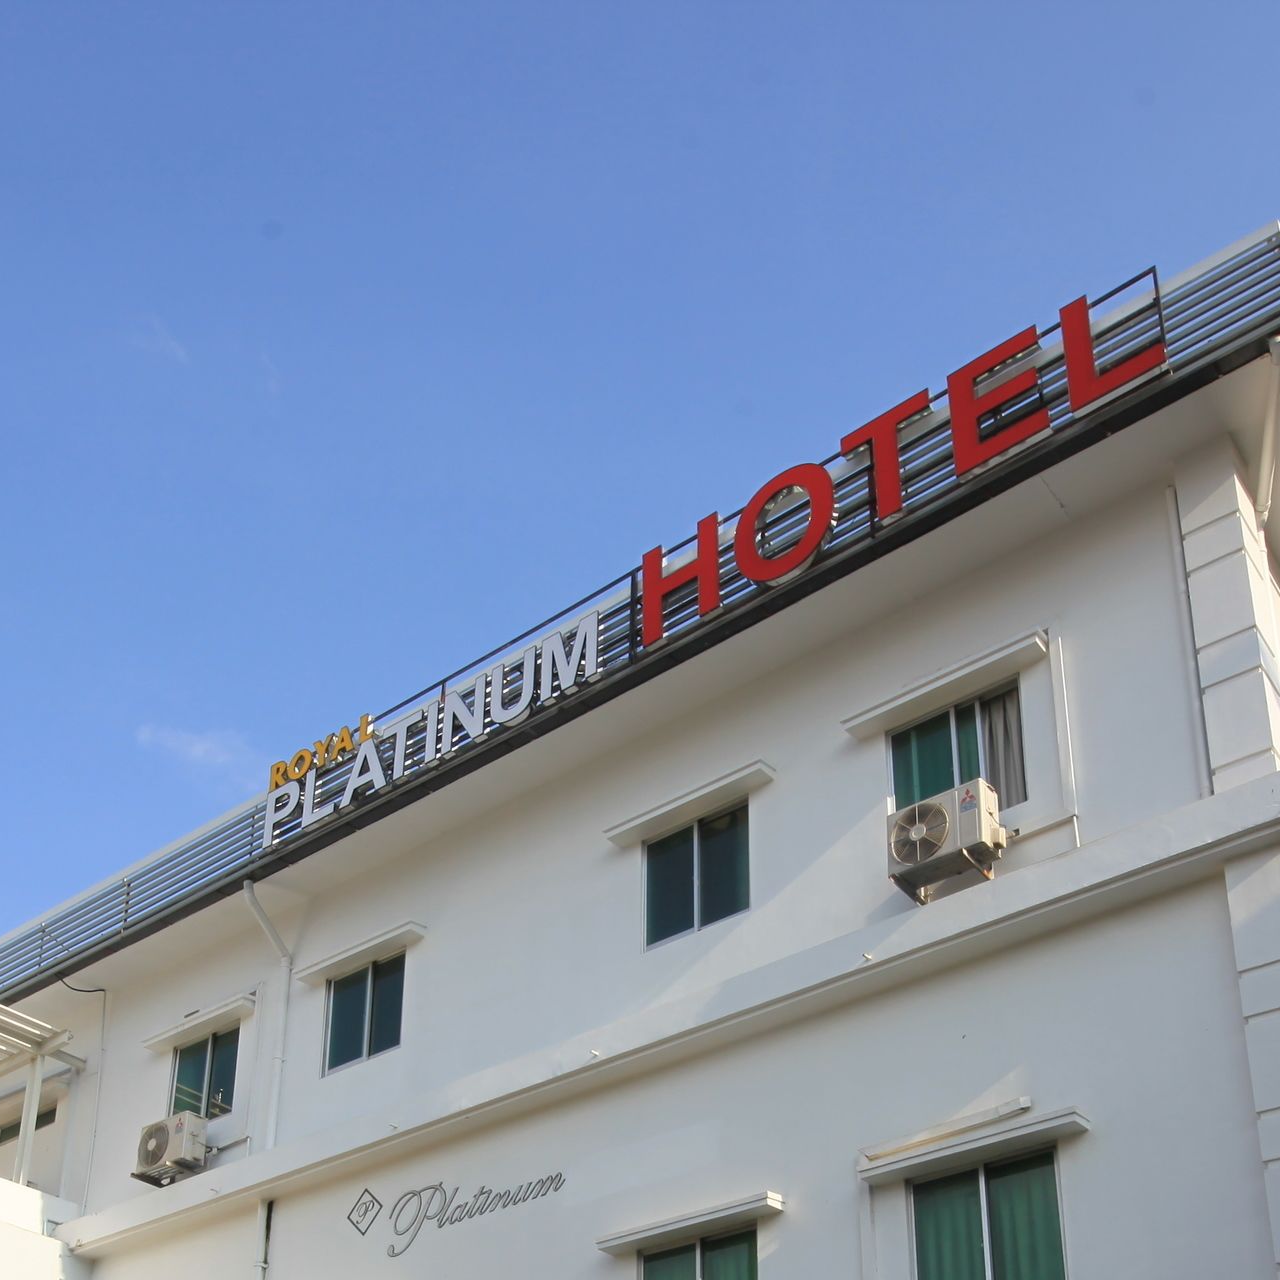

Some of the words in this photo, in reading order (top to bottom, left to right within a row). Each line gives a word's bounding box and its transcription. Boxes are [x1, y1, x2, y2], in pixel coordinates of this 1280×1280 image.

[262, 610, 601, 850] PLATINUM
[641, 294, 1166, 648] HOTEL
[269, 713, 375, 792] ROYAL
[386, 1171, 567, 1258] Platinum
